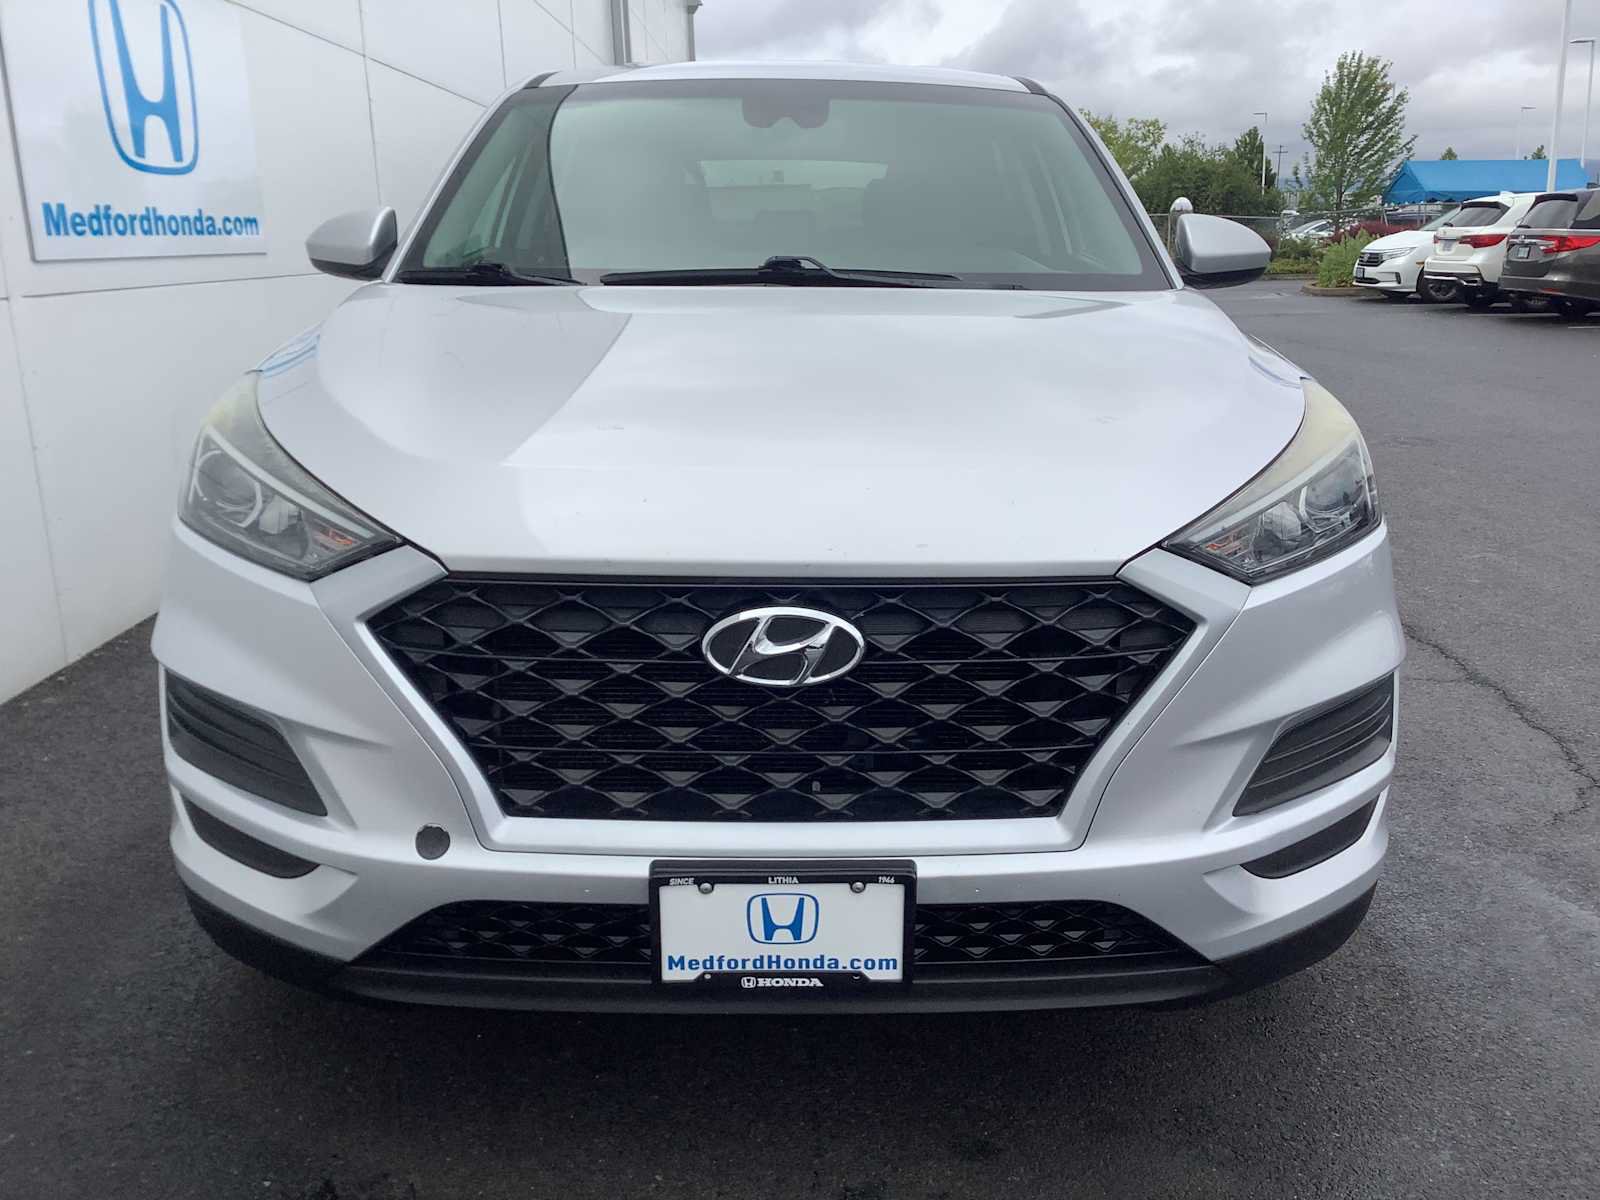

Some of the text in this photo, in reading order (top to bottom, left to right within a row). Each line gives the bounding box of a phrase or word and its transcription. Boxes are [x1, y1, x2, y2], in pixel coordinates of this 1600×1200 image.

[42, 201, 259, 237] Medfordhonda.com
[669, 877, 695, 886] SINCE
[768, 876, 799, 884] LITHIA
[667, 954, 898, 970] MedfordHonda.com
[757, 977, 823, 987] HONDA
